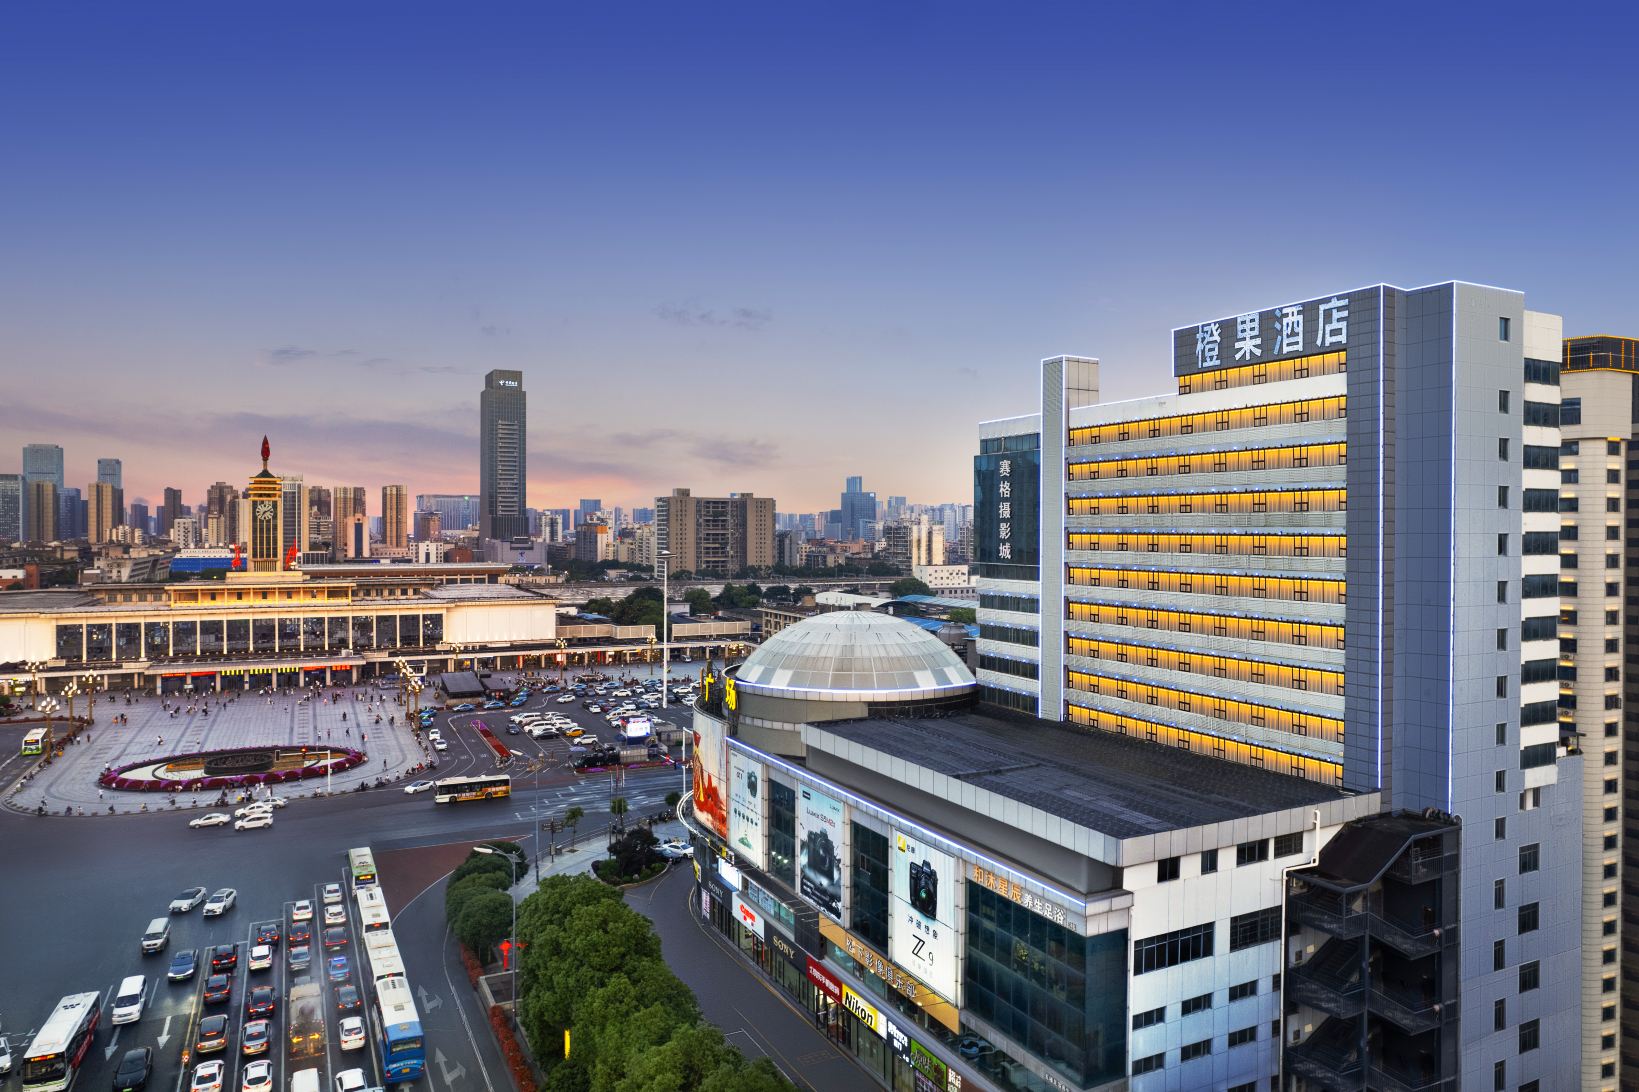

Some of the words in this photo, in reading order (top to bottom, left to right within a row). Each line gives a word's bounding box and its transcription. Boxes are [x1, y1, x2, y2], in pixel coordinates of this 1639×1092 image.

[1195, 296, 1349, 369] 橙果酒店
[998, 459, 1012, 560] 赛格摄影城
[708, 880, 724, 899] SONY
[973, 864, 1023, 905] 和沐星辰
[772, 935, 796, 960] SONY
[844, 991, 874, 1027] Nikon
